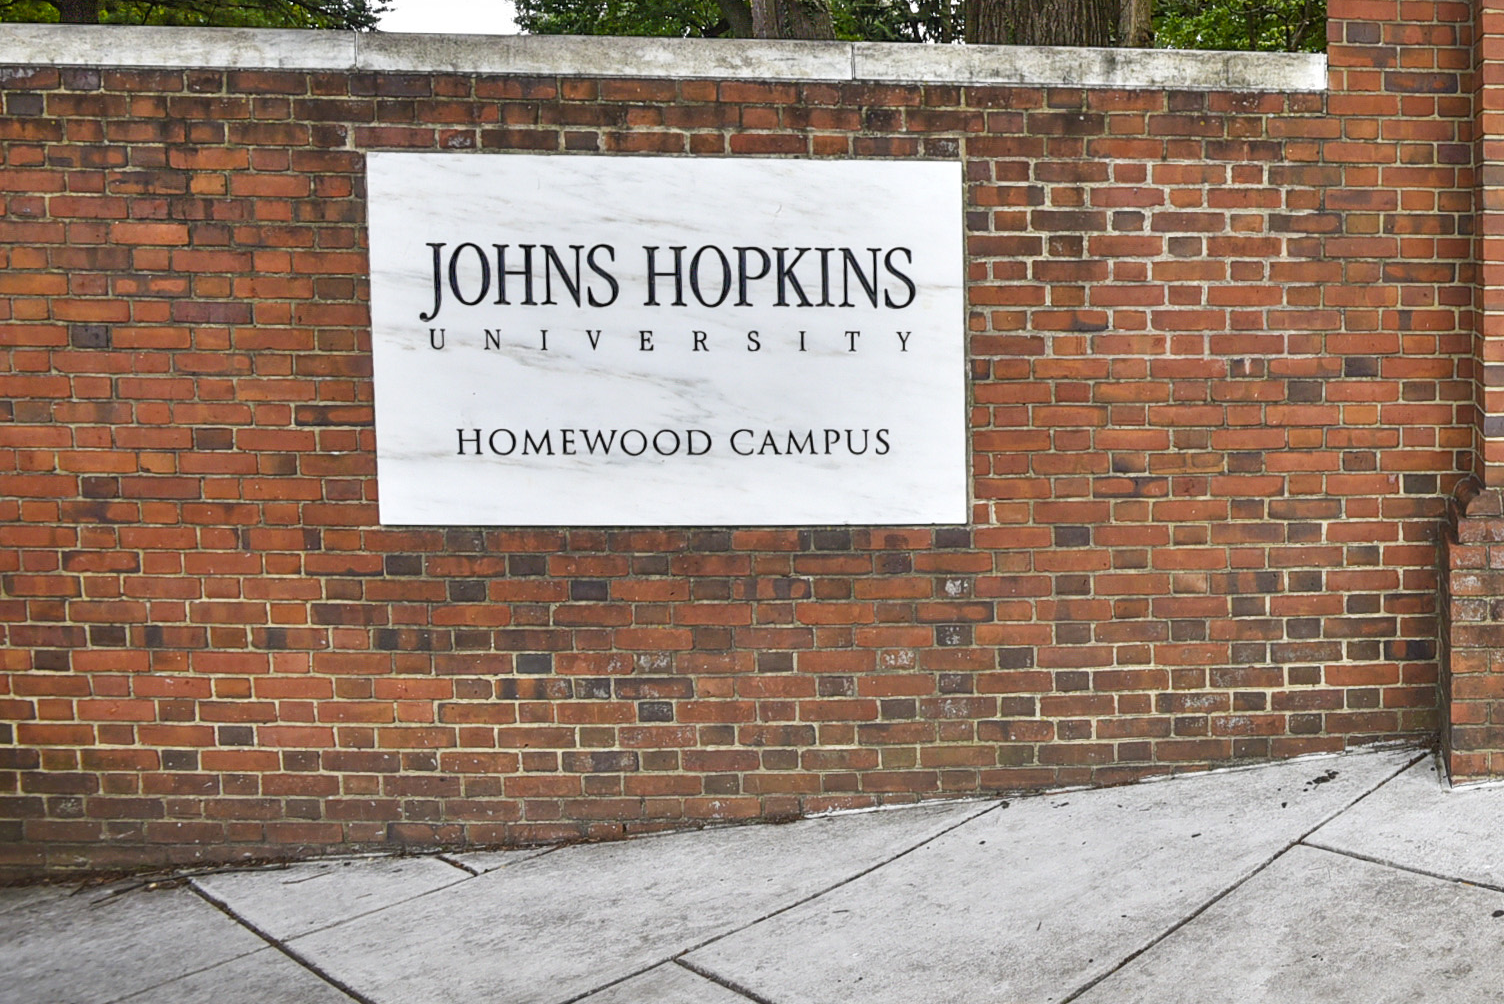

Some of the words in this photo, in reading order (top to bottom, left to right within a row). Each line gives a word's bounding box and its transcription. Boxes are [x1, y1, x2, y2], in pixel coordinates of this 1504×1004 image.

[419, 241, 620, 323] JOHNS
[642, 244, 917, 310] HOPKINS
[428, 328, 913, 352] UNIVERSITY
[456, 428, 713, 457] HOMEWOOD
[729, 428, 892, 456] CAMPUS
